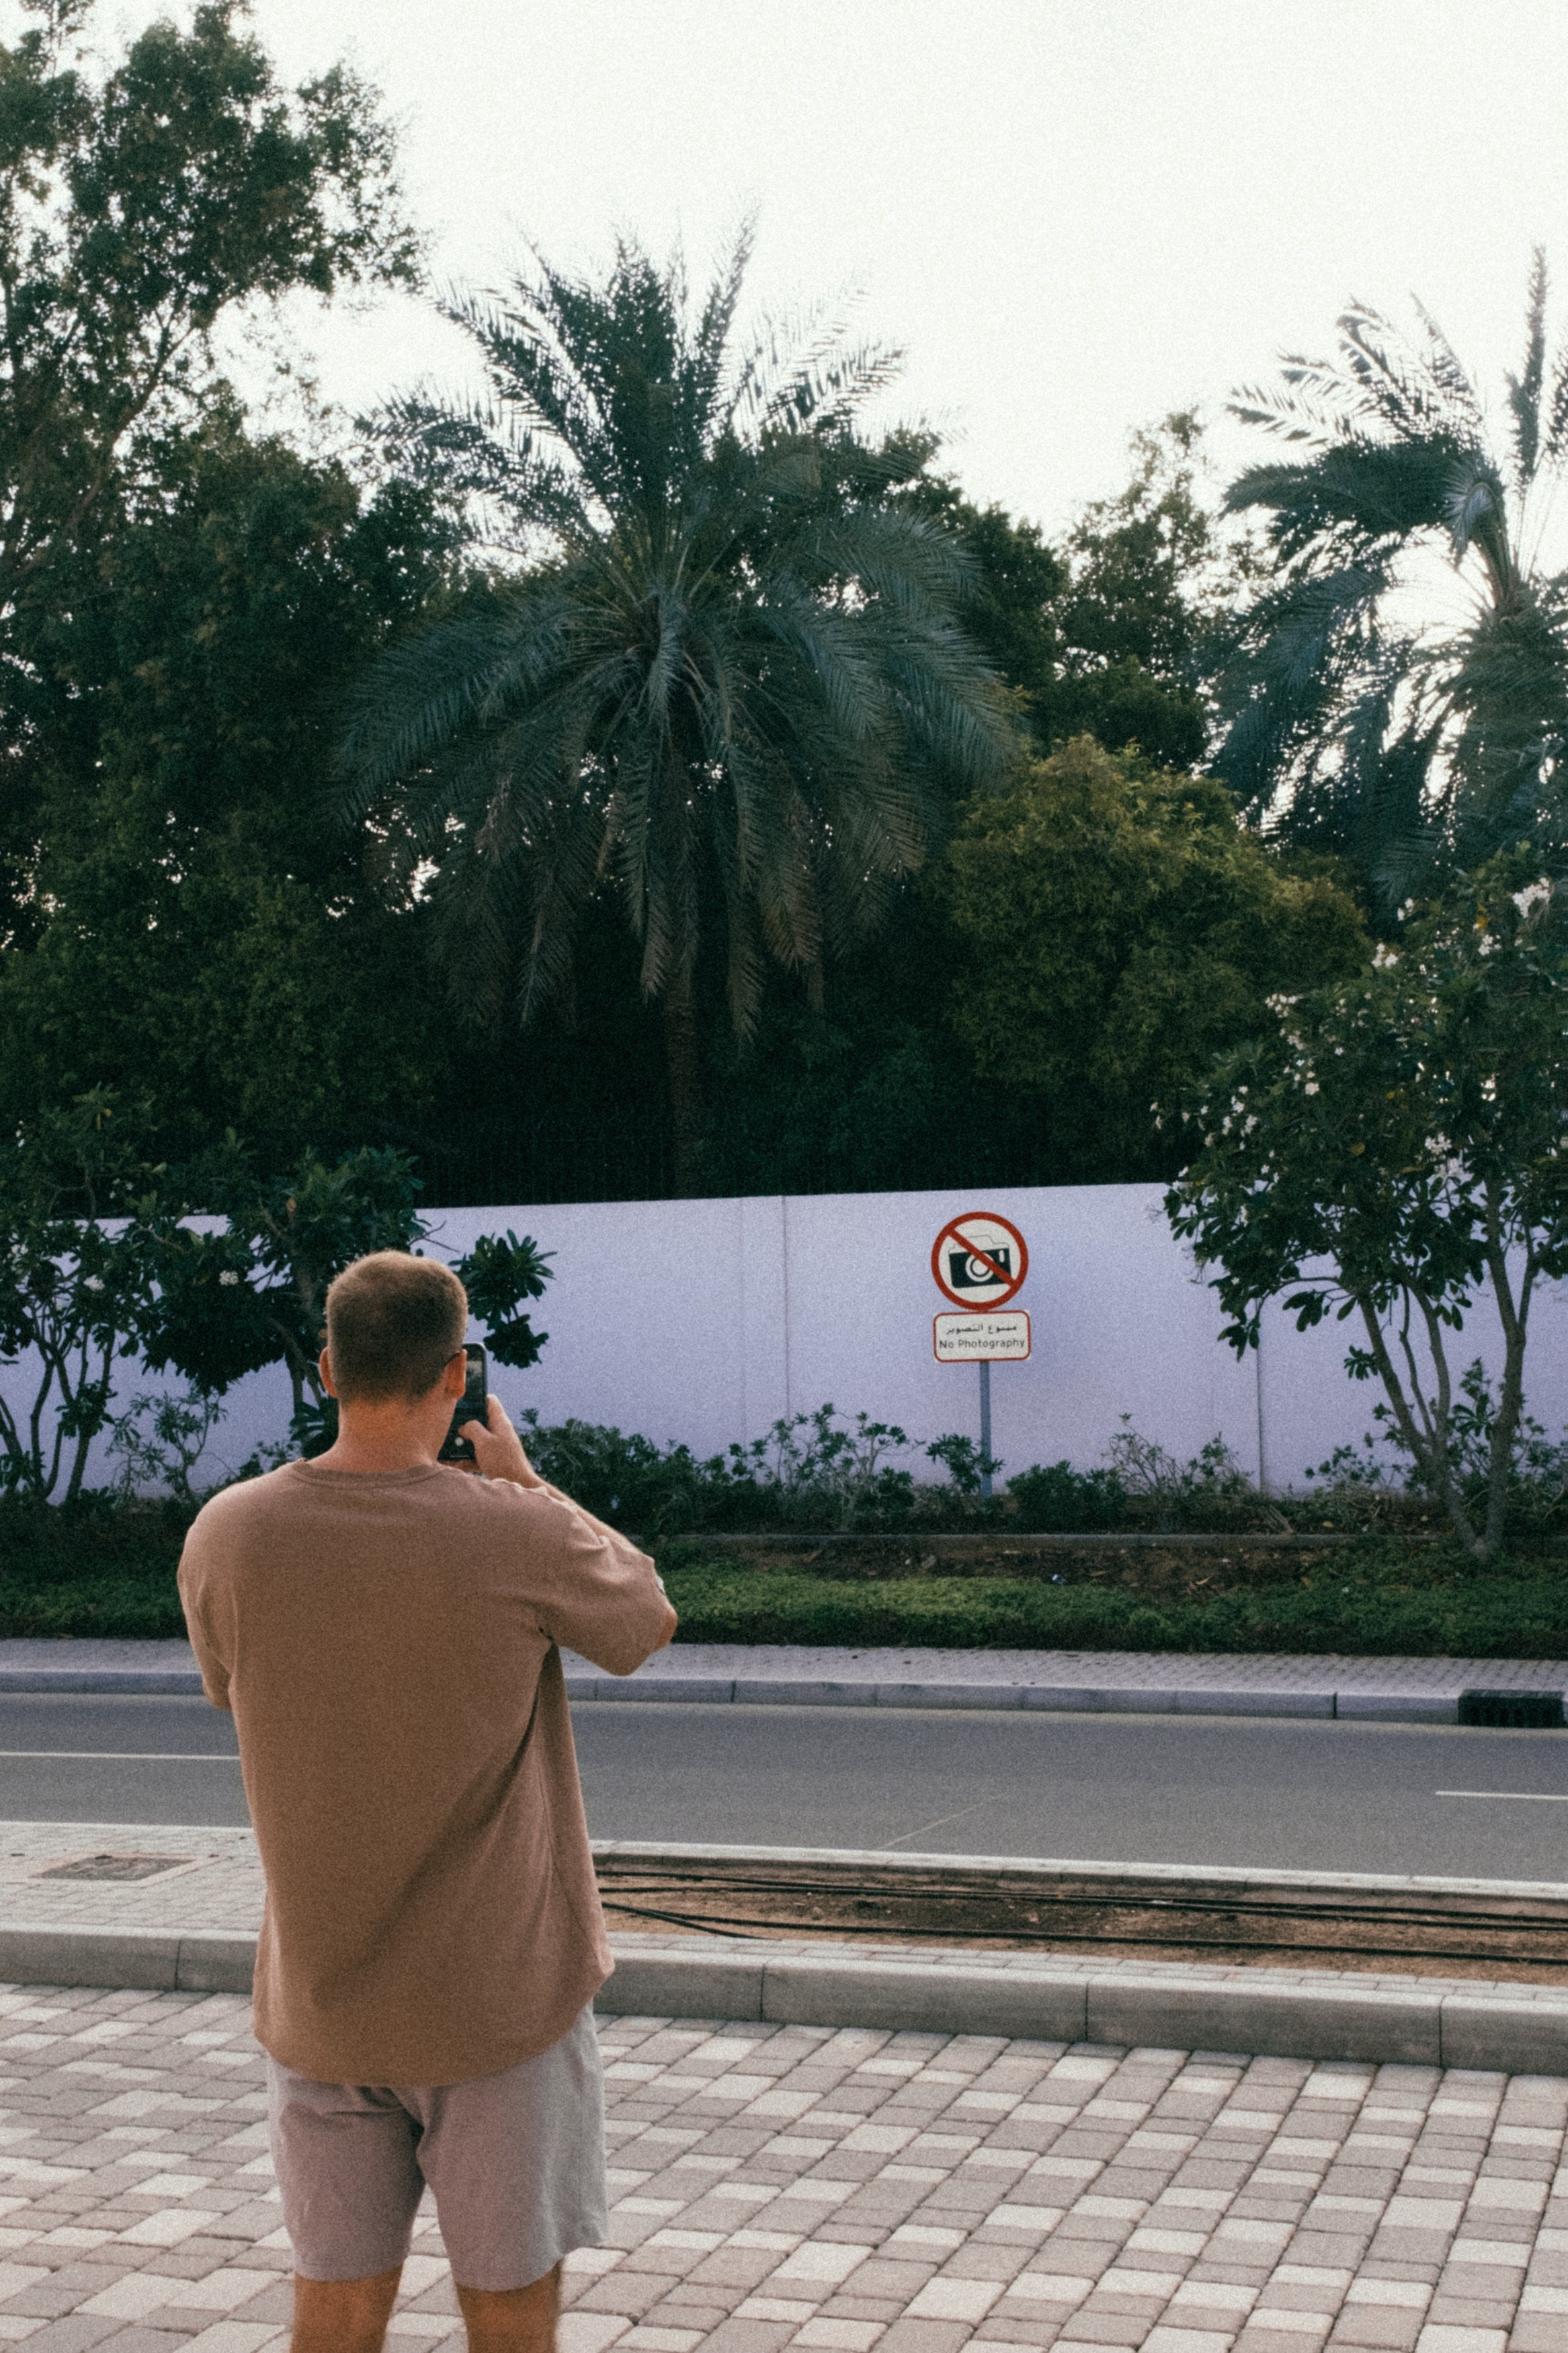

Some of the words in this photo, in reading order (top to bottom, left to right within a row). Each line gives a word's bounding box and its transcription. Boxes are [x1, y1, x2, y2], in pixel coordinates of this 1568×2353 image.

[946, 1323, 983, 1334] التصوير
[987, 1324, 1017, 1334] ممنوع
[939, 1340, 954, 1349] No
[958, 1338, 1024, 1349] Photography
